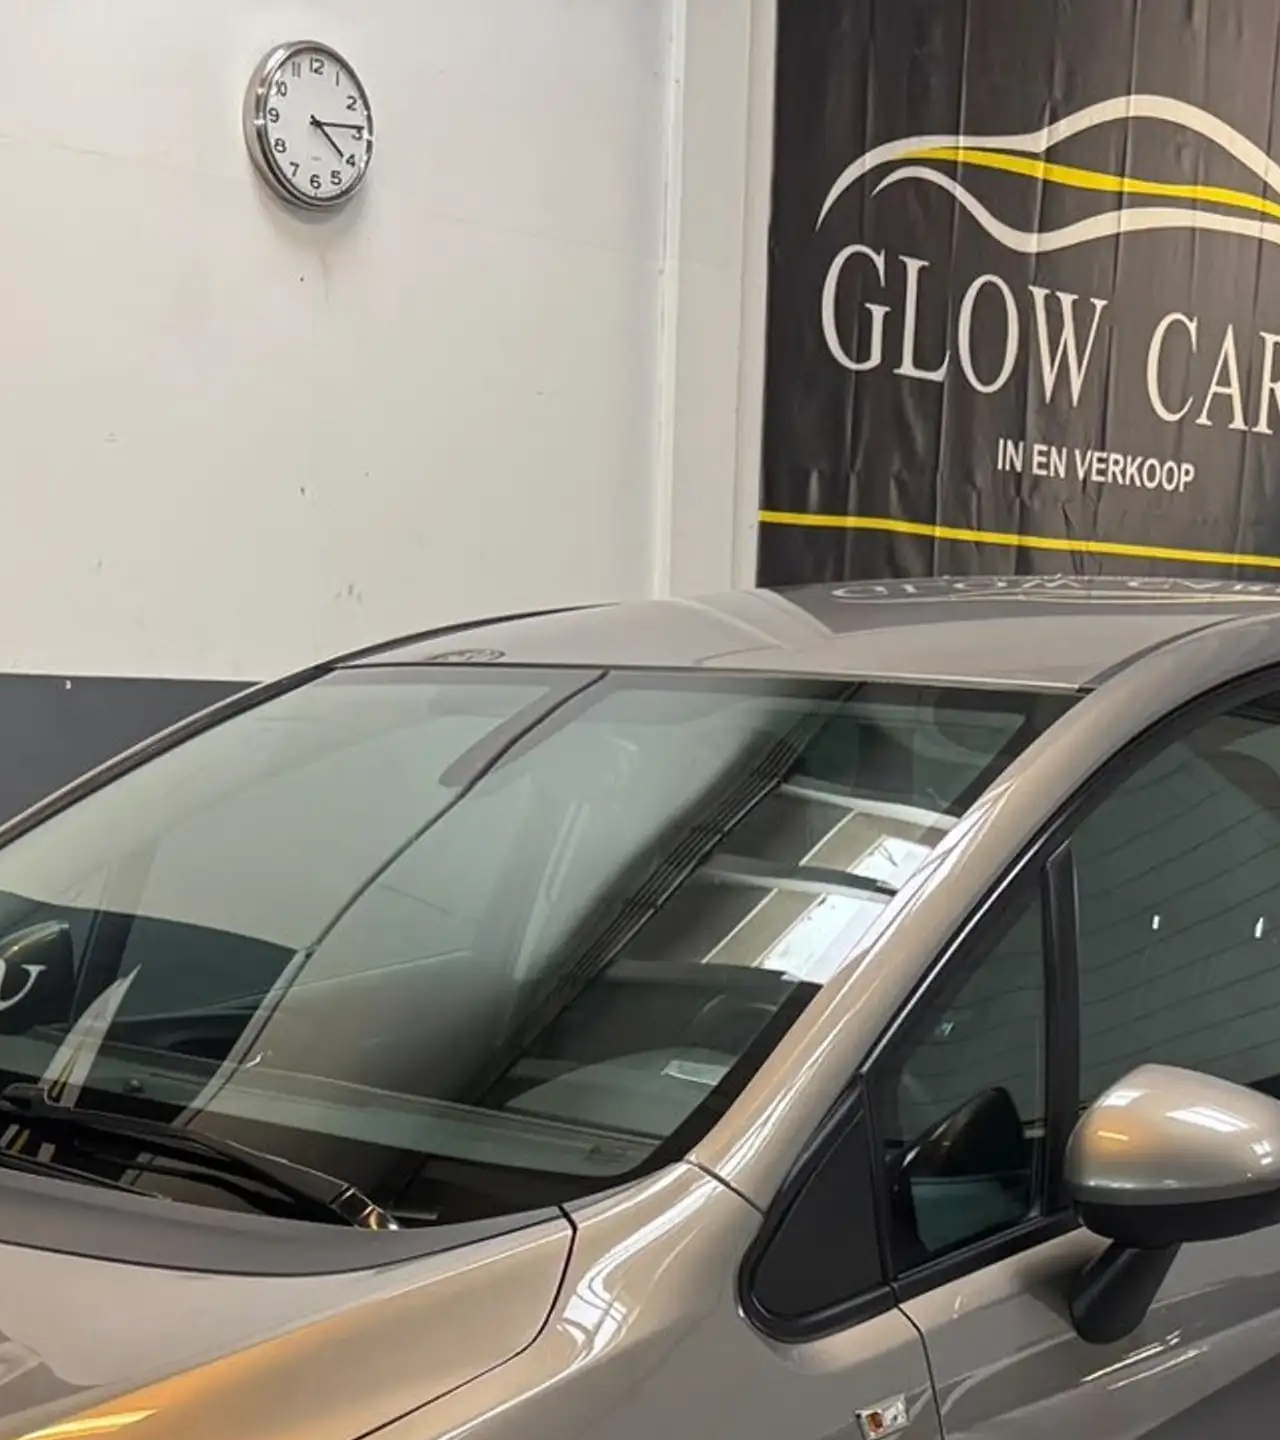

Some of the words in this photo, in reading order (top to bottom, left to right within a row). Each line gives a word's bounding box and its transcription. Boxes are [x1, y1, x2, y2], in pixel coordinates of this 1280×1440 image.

[309, 57, 325, 75] 12
[346, 95, 357, 111] 2
[268, 107, 280, 123] 9
[351, 126, 364, 141] 3
[274, 138, 287, 153] 8
[290, 161, 300, 177] 7
[345, 154, 356, 168] 4
[309, 174, 321, 189] 6
[330, 170, 342, 185] 5
[820, 244, 1108, 408] GLOW
[997, 438, 1024, 473] IN
[1031, 443, 1067, 480] EN
[1074, 448, 1195, 494] VERKOOP
